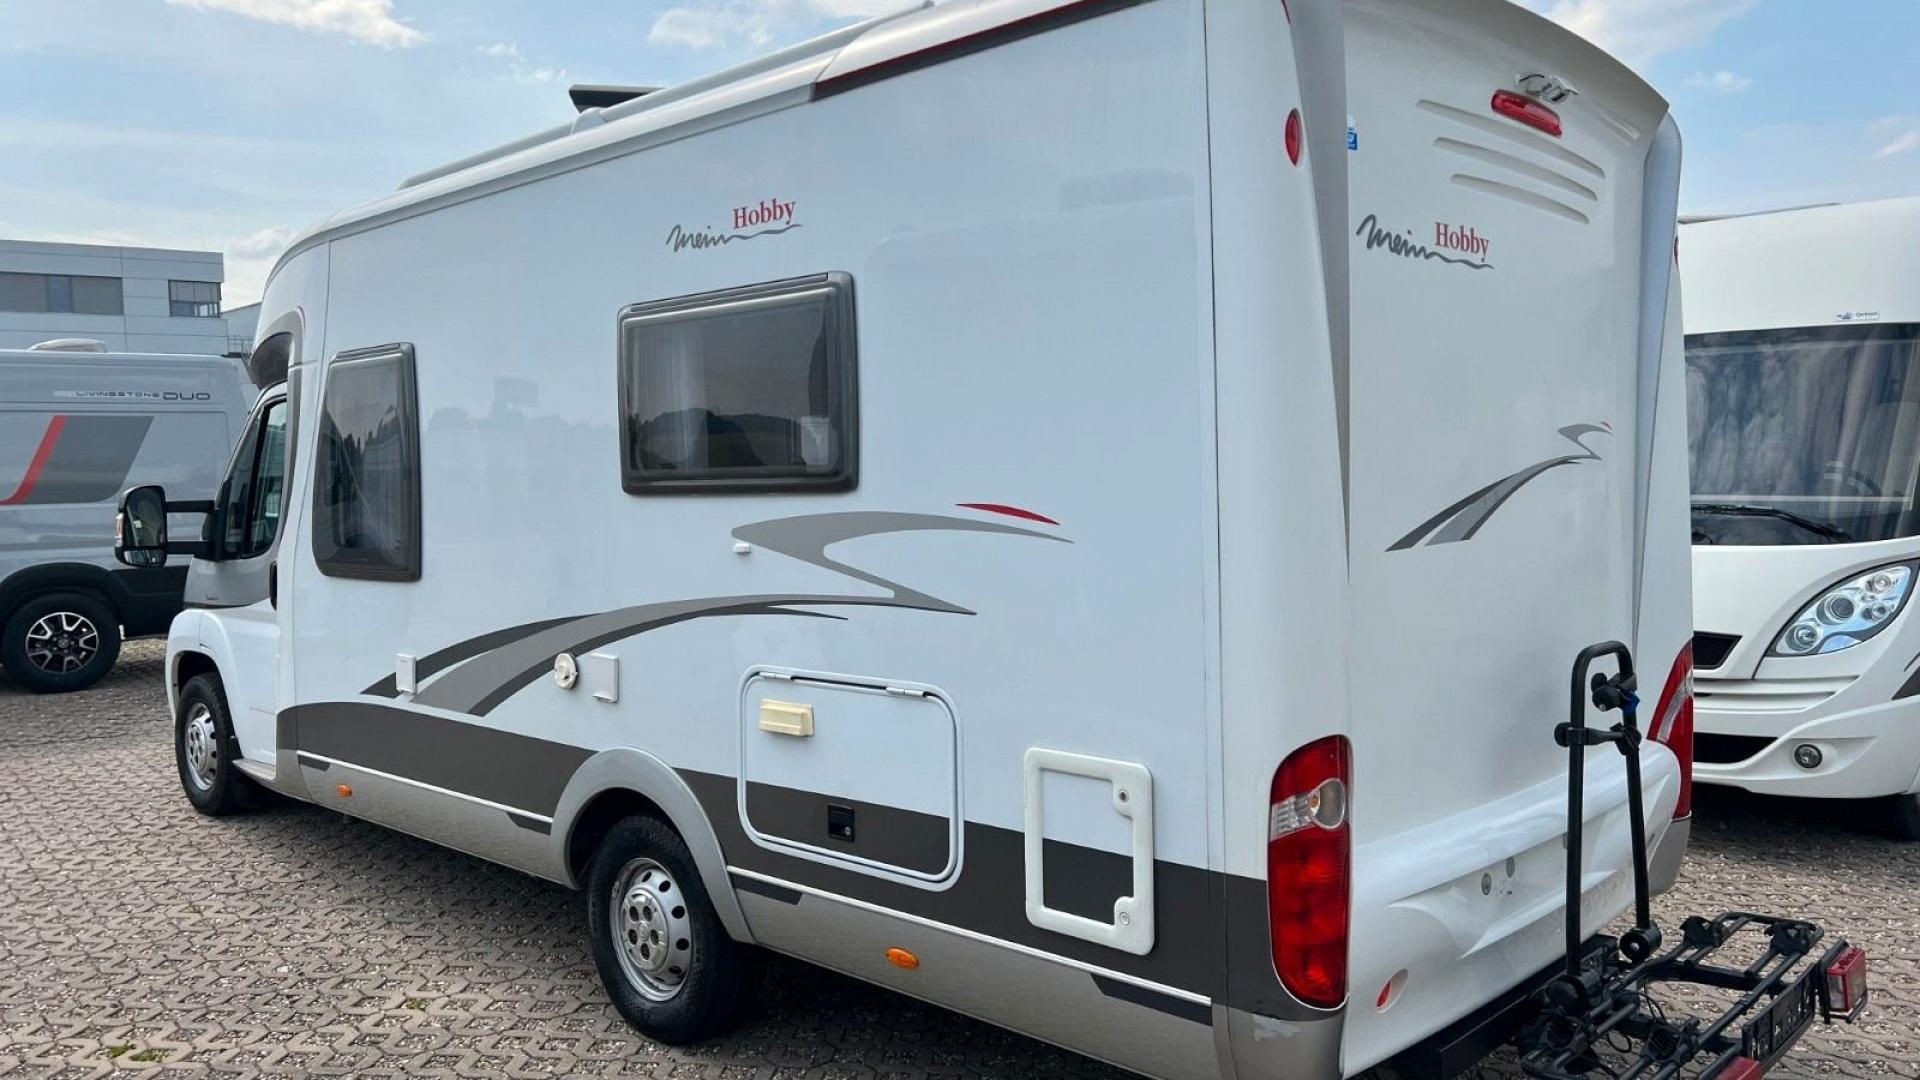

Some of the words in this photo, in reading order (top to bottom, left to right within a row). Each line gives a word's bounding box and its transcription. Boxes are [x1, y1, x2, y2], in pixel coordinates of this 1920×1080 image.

[732, 198, 796, 229] Hobby
[1434, 221, 1490, 263] Hobby
[162, 391, 211, 400] DUO
